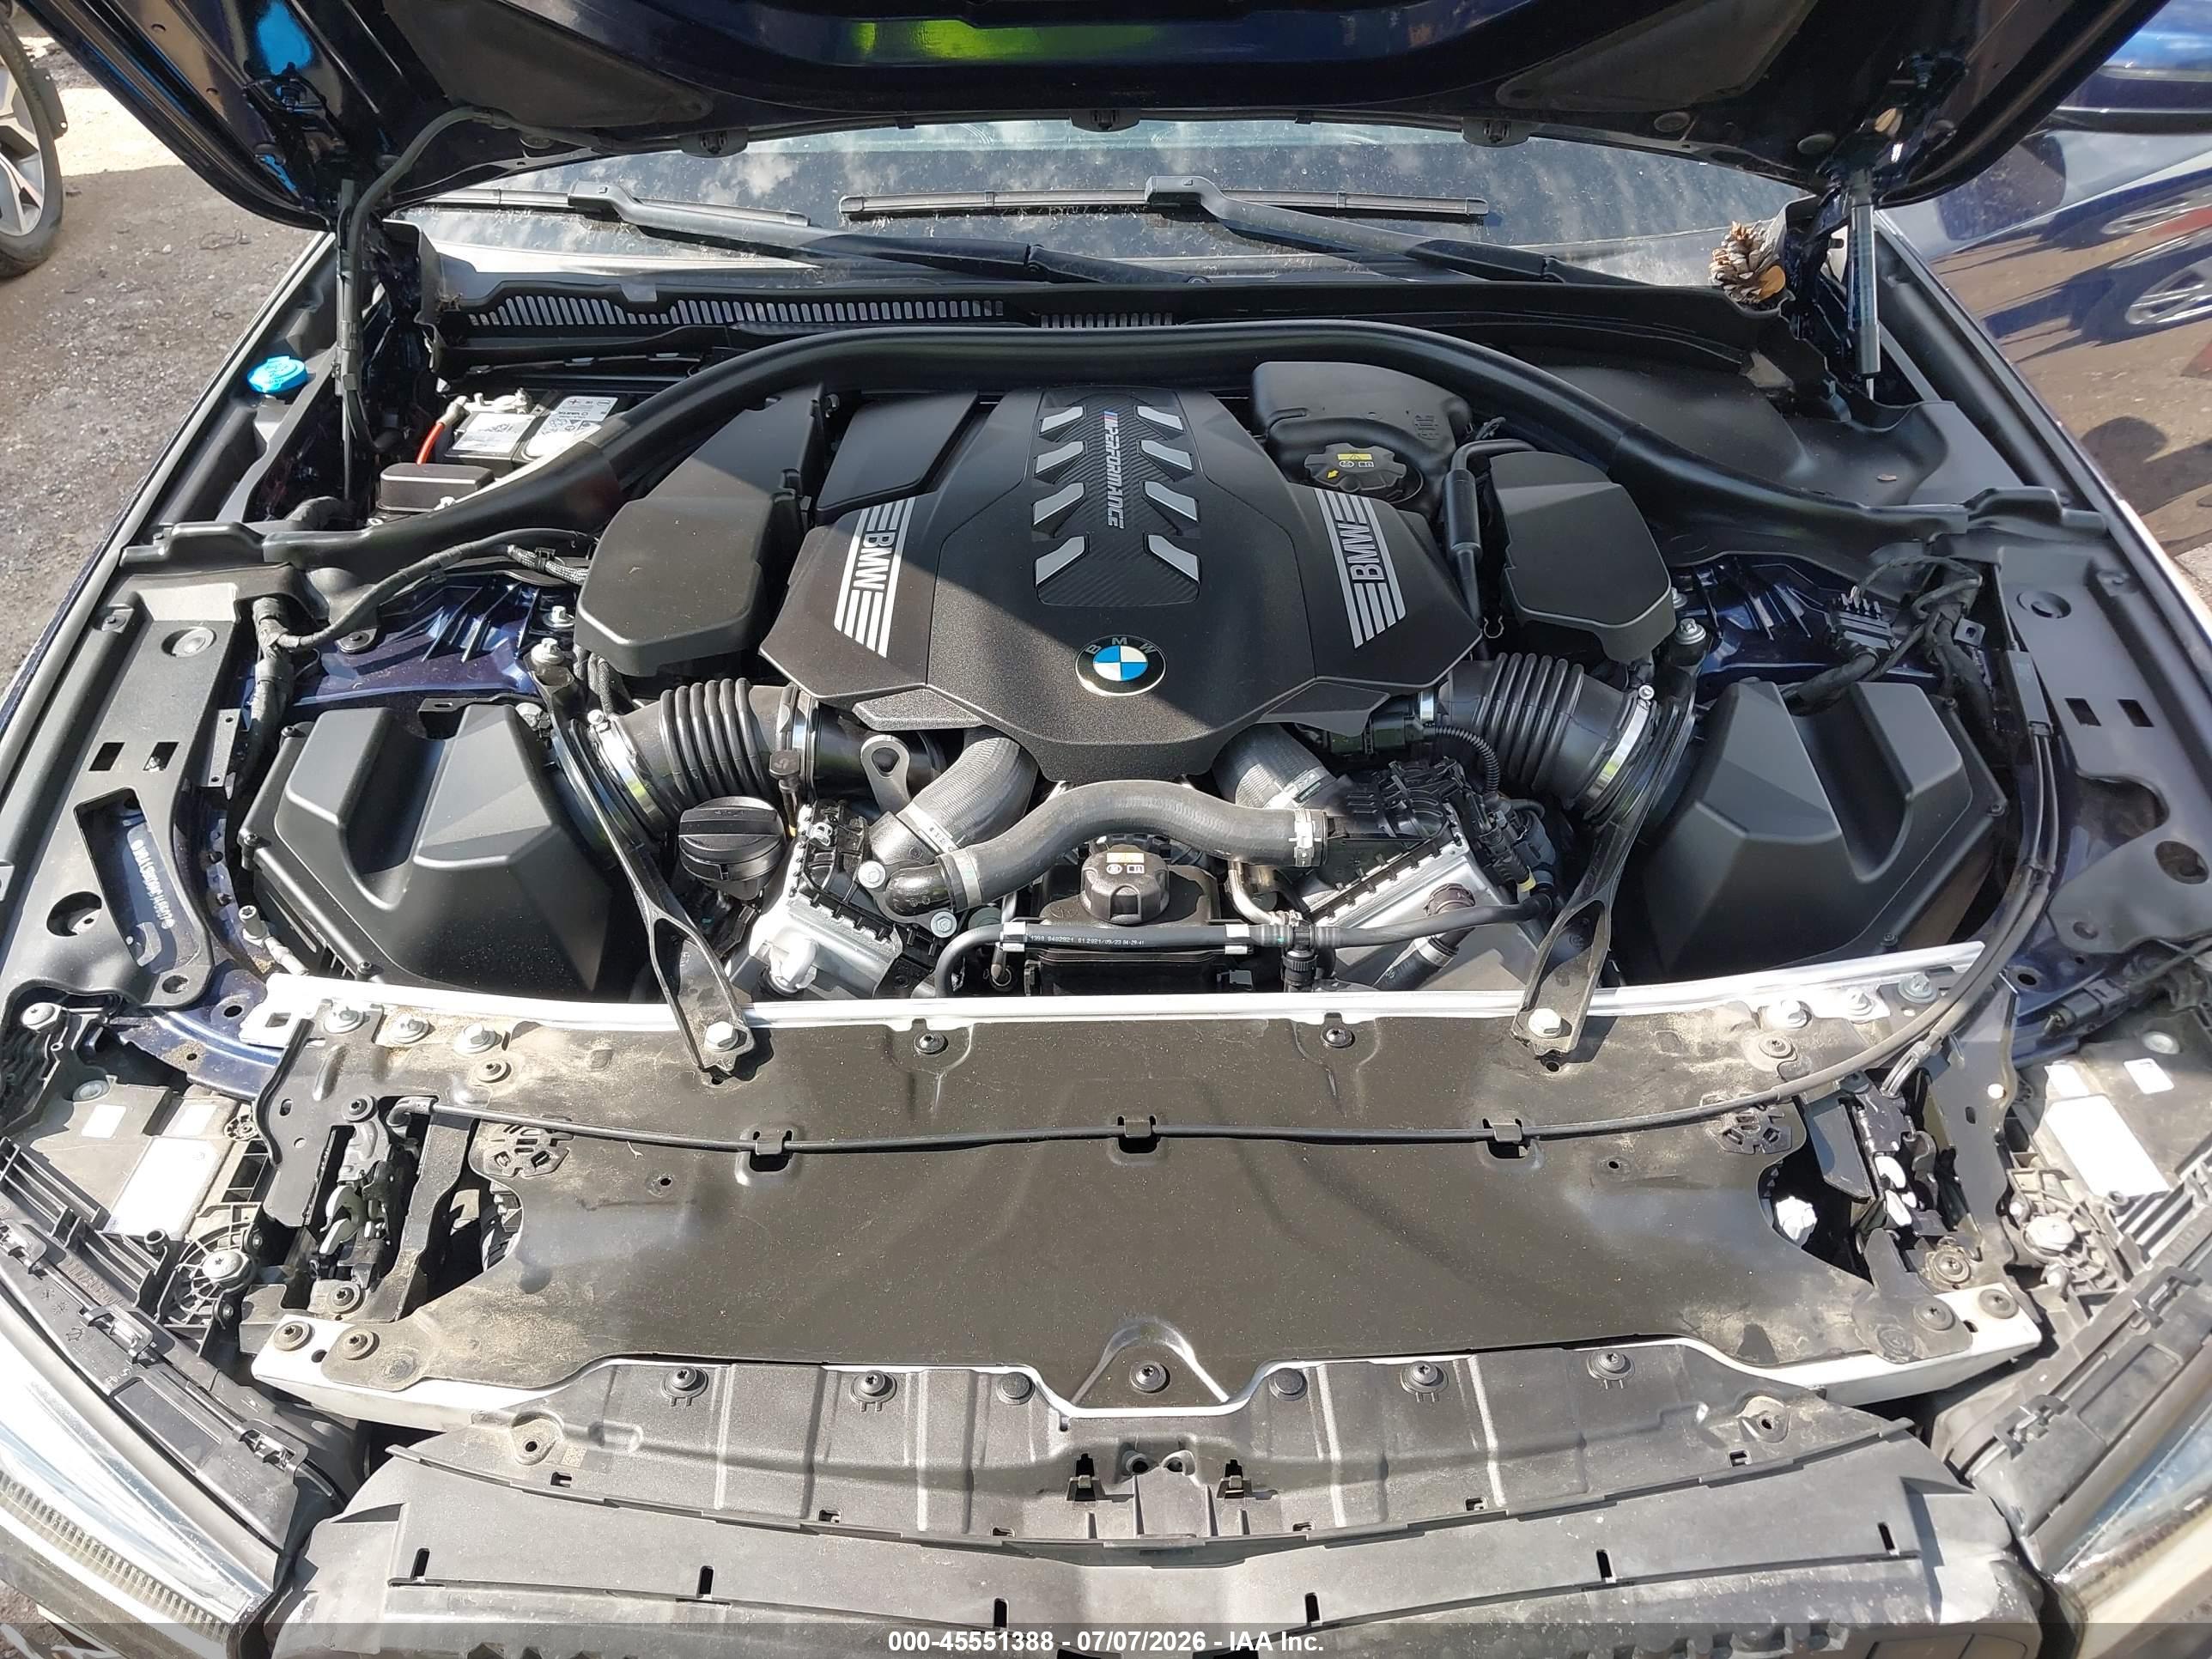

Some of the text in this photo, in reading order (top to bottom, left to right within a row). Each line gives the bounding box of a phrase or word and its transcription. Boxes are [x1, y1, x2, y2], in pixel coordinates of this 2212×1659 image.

[1104, 428, 1125, 529] PERFORMANCE
[853, 532, 896, 590] BMW
[1338, 523, 1385, 580] BMW
[1085, 636, 1158, 654] BMW
